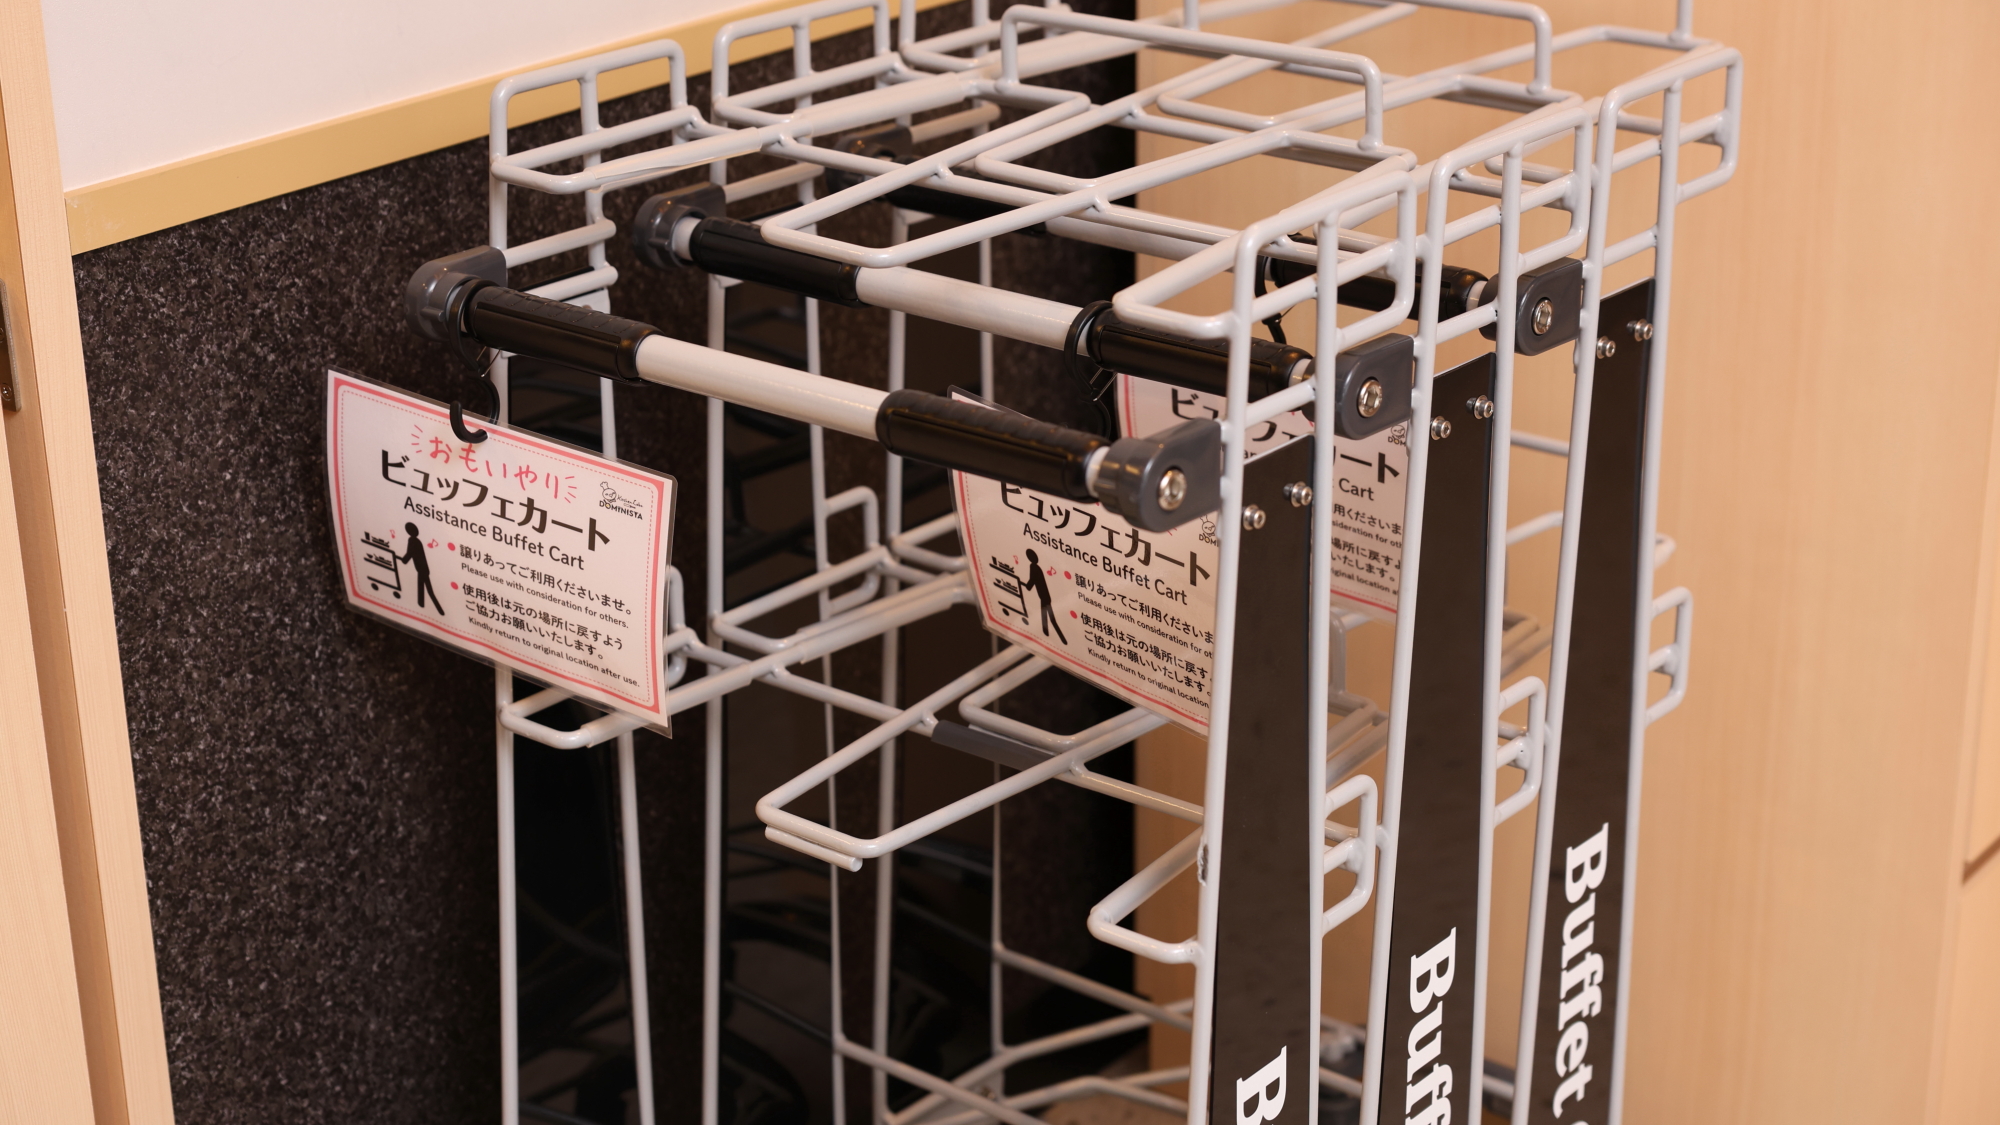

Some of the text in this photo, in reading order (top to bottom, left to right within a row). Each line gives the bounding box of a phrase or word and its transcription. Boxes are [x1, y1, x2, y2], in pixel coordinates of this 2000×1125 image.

[381, 449, 611, 552] ビュッフェカート
[428, 436, 559, 499] おもいやり
[1338, 477, 1374, 502] Cart
[403, 496, 584, 571] Assistance Buffet Cart
[599, 500, 643, 520] DOMINISTA
[1375, 534, 1388, 545] for
[459, 543, 632, 616] 譲りあってご利用くださいませ。
[461, 562, 630, 629] Please use with consideration for others.
[1023, 522, 1188, 606] Assistance Buffet Cart
[1356, 575, 1390, 593] location
[462, 583, 623, 651] 使用後は元の場所に戻すよう
[465, 599, 604, 660] ご協力お願いいたします。
[1077, 591, 1102, 610] Please
[1103, 605, 1117, 616] use
[1117, 611, 1136, 625] with
[1136, 619, 1189, 649] consideration
[1190, 642, 1202, 654] for
[1080, 612, 1213, 683] 使用後は元の場所に戻す
[468, 616, 641, 688] Kindly return to original location after use.
[1087, 647, 1210, 709] Kindly return to original location
[1553, 822, 1609, 1119] Buffet
